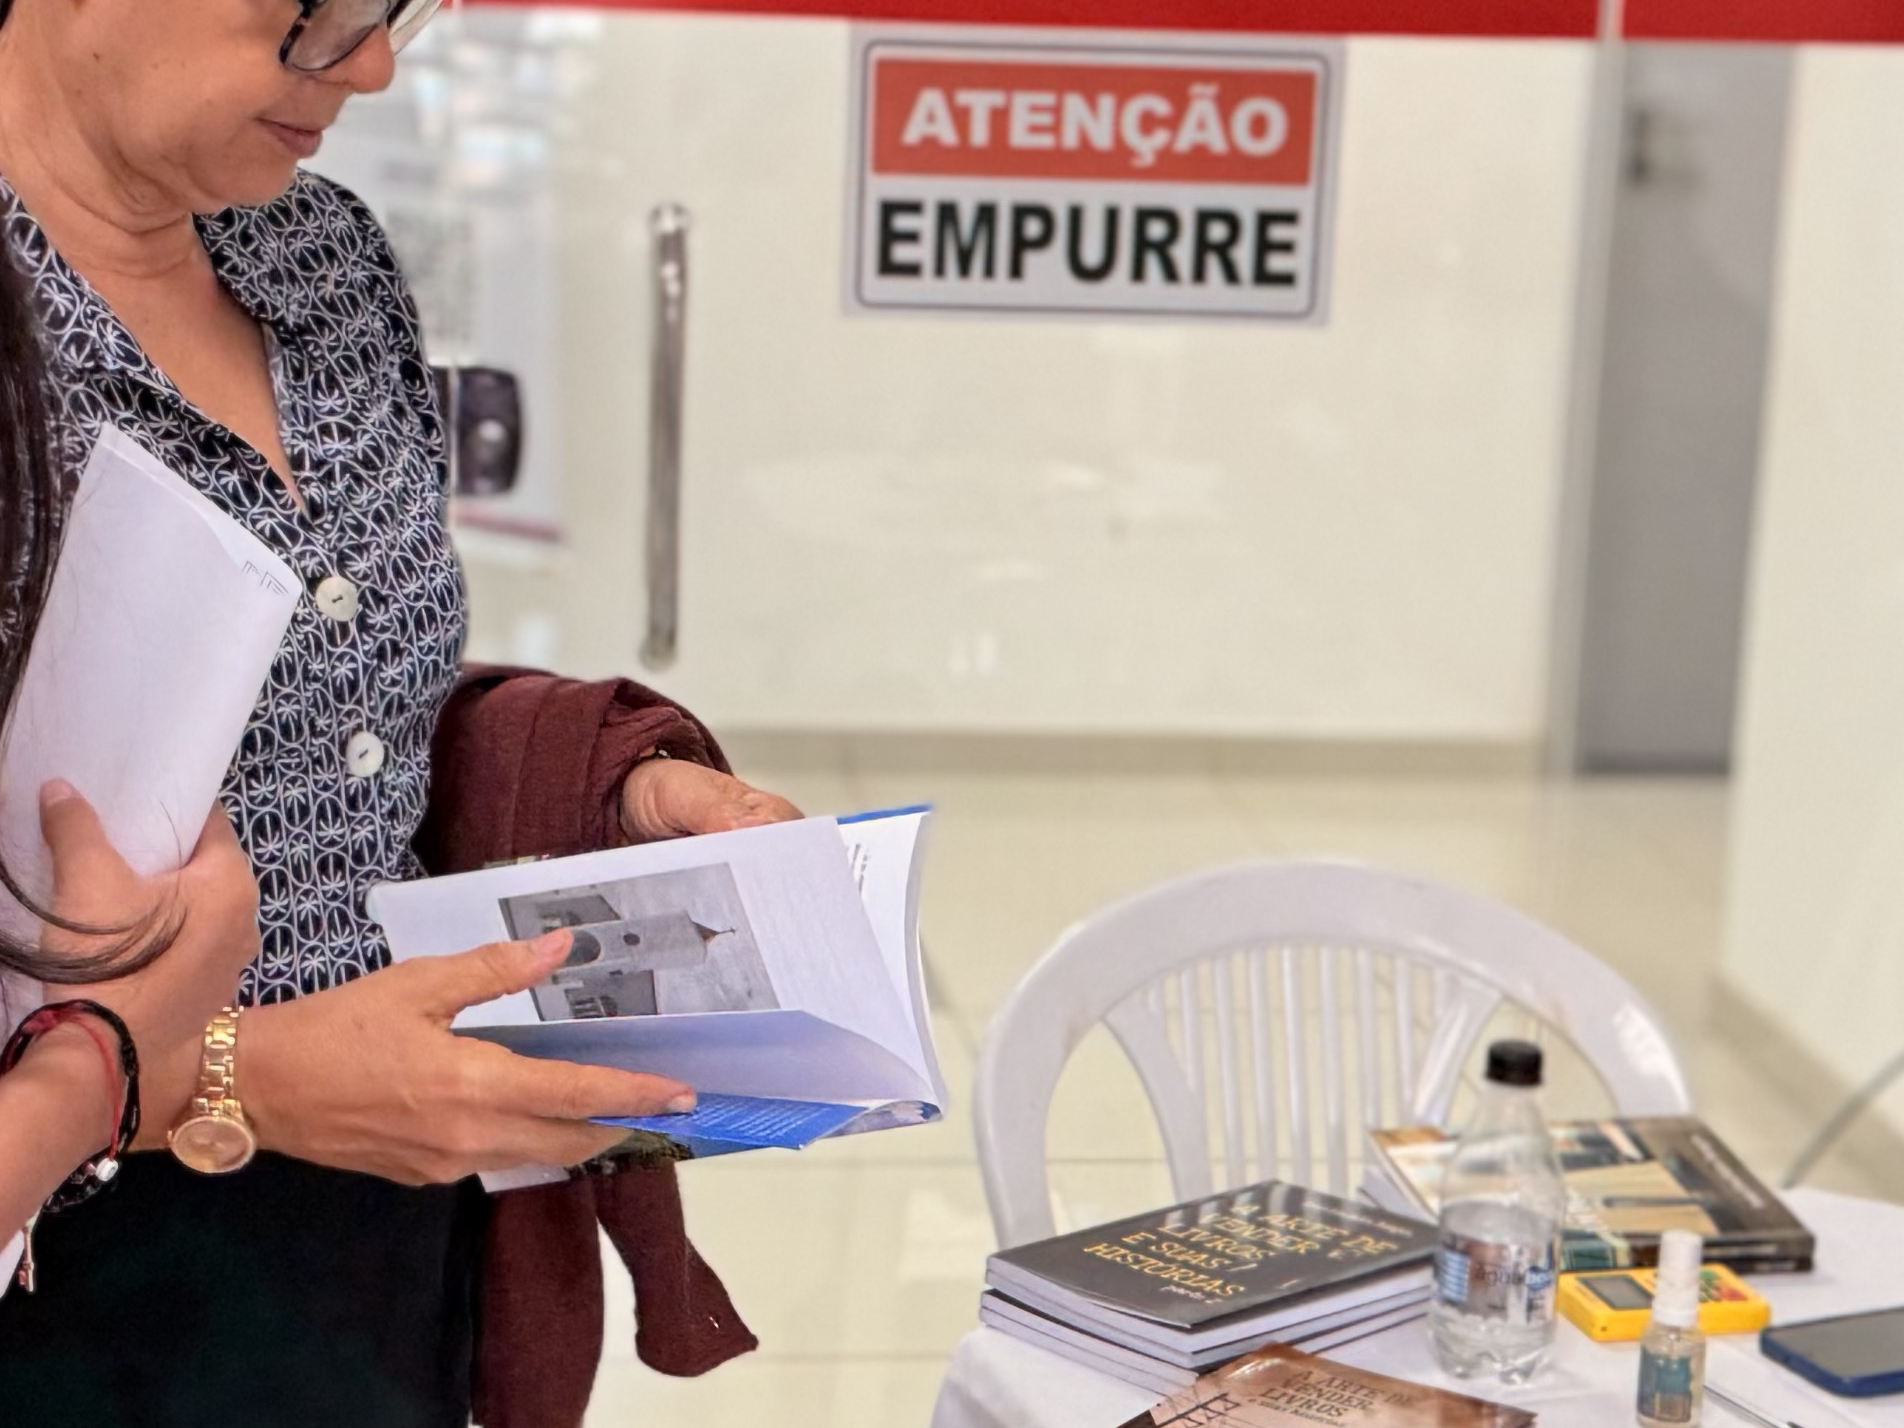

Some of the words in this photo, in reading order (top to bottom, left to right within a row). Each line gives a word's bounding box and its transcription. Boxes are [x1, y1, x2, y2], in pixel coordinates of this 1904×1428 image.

[901, 82, 1290, 168] ATENÇÃO
[877, 200, 1301, 288] EMPURRE
[1121, 1232, 1158, 1246] E
[1150, 1241, 1234, 1270] SUAS
[1157, 1223, 1277, 1260] LIVROS
[1200, 1213, 1321, 1255] VENDER
[1342, 1235, 1399, 1256] DE
[1260, 1387, 1349, 1419] LIVROS
[1282, 1380, 1375, 1410] VENDER
[1316, 1375, 1384, 1400] ARTE
